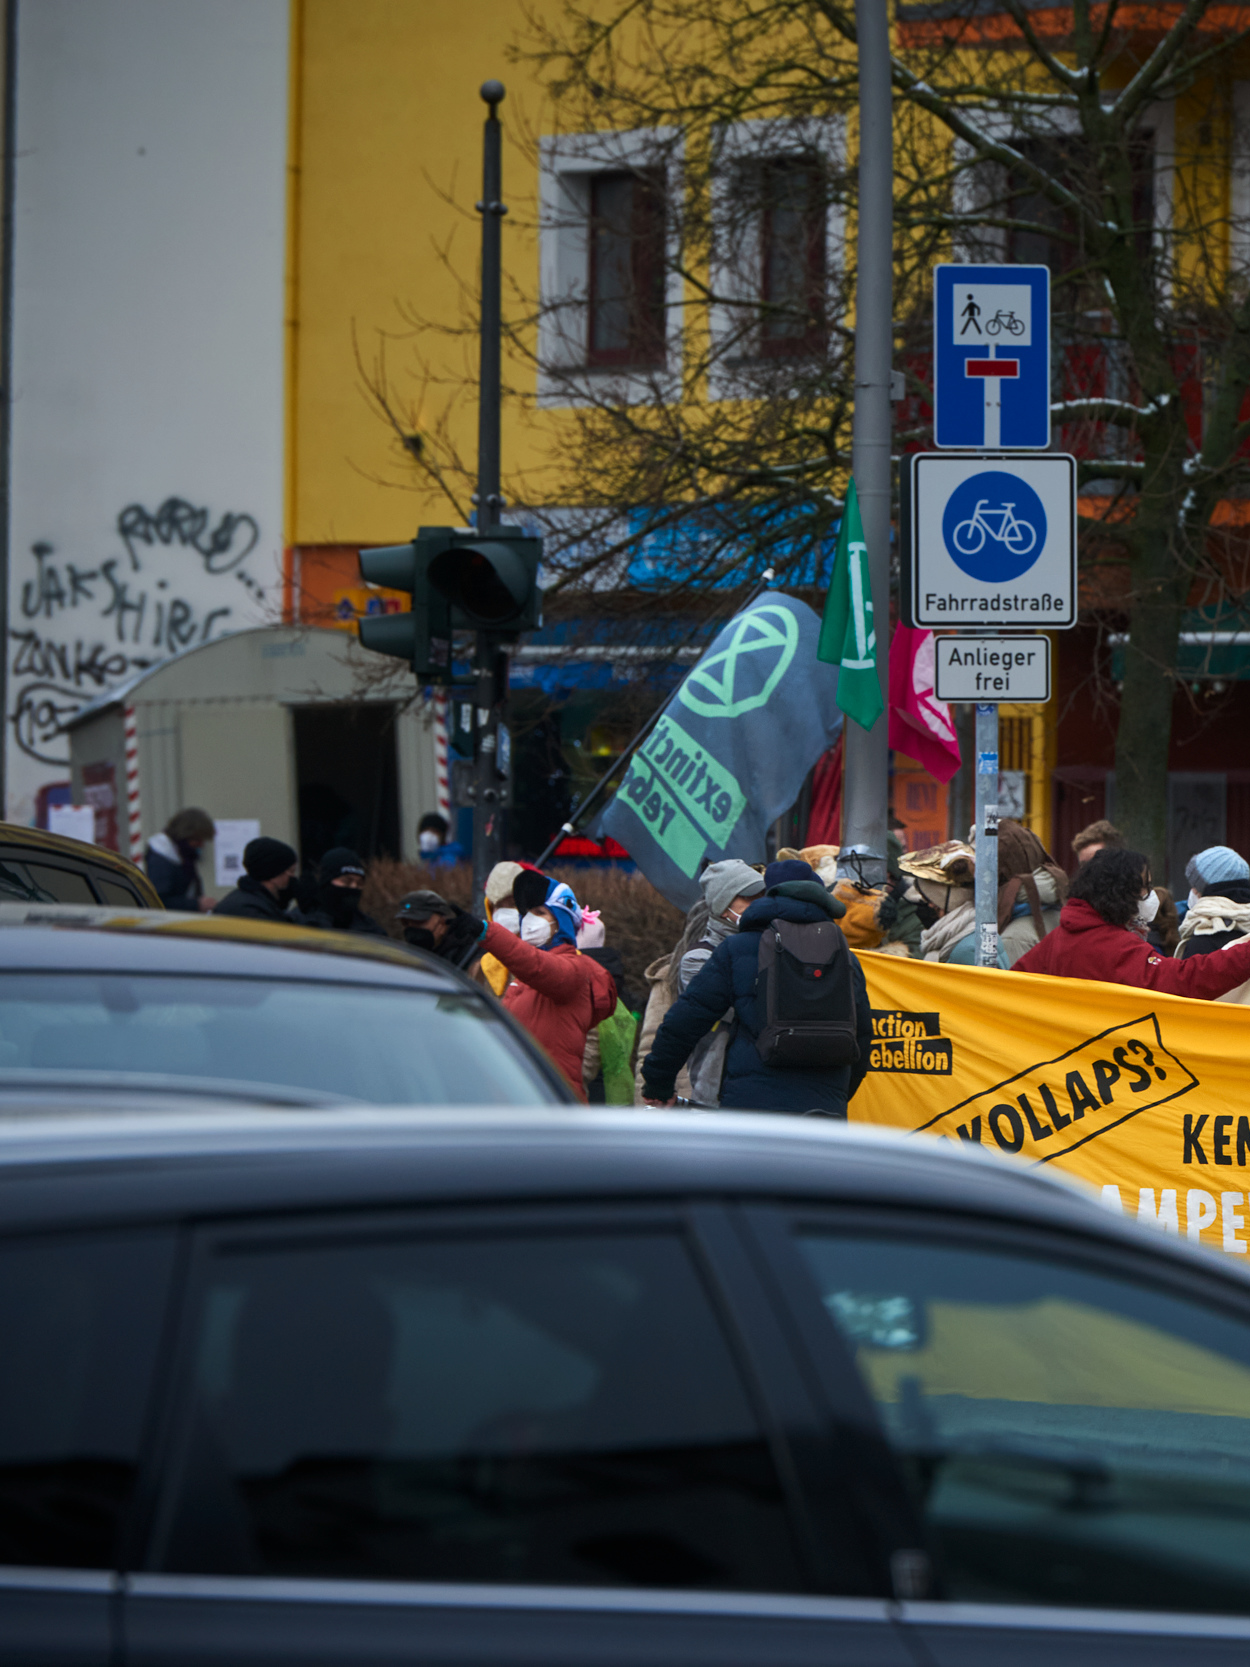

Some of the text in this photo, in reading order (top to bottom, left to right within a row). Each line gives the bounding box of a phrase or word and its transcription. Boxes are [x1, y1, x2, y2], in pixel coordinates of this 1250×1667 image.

[926, 593, 1064, 611] Fahrradstraße
[948, 647, 1036, 671] Anlieger
[975, 672, 1010, 691] frei
[869, 1039, 949, 1071] ebellion
[955, 1039, 1167, 1154] KOLLAPS?
